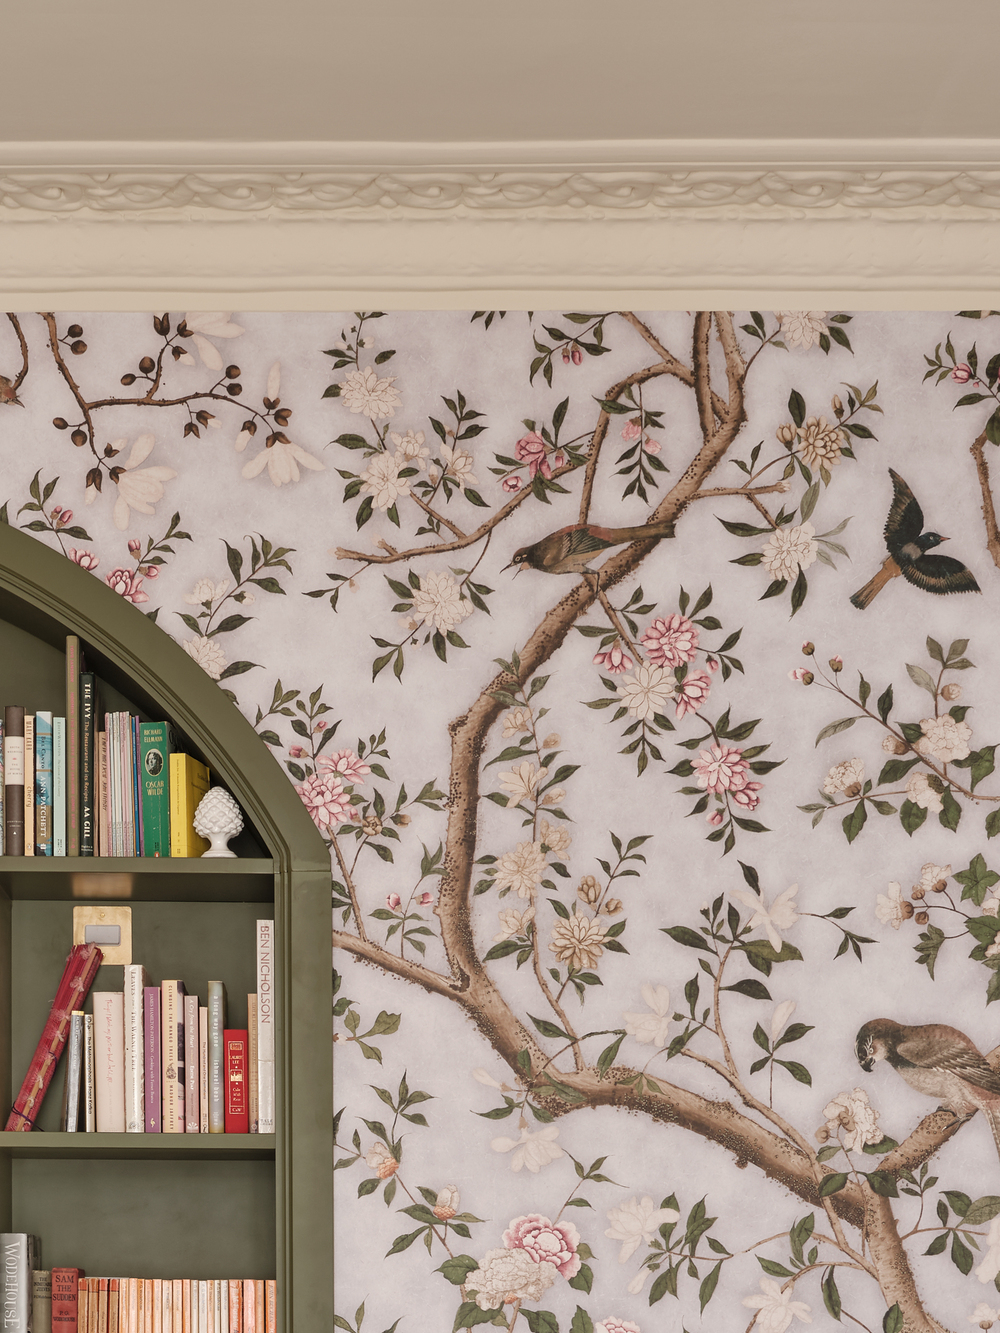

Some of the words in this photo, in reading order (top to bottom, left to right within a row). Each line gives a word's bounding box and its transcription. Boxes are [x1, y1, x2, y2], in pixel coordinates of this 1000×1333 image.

[145, 781, 165, 789] OSCAR
[25, 786, 33, 808] cherry
[147, 788, 164, 796] WILDE
[83, 806, 91, 818] AA
[83, 820, 91, 839] GILL
[260, 925, 270, 949] BEN
[261, 952, 271, 1024] NICHOLSON
[55, 1274, 74, 1284] SAM
[4, 1242, 21, 1329] WODEHOUSE
[56, 1284, 72, 1292] THE
[52, 1293, 76, 1301] SUDDEN
